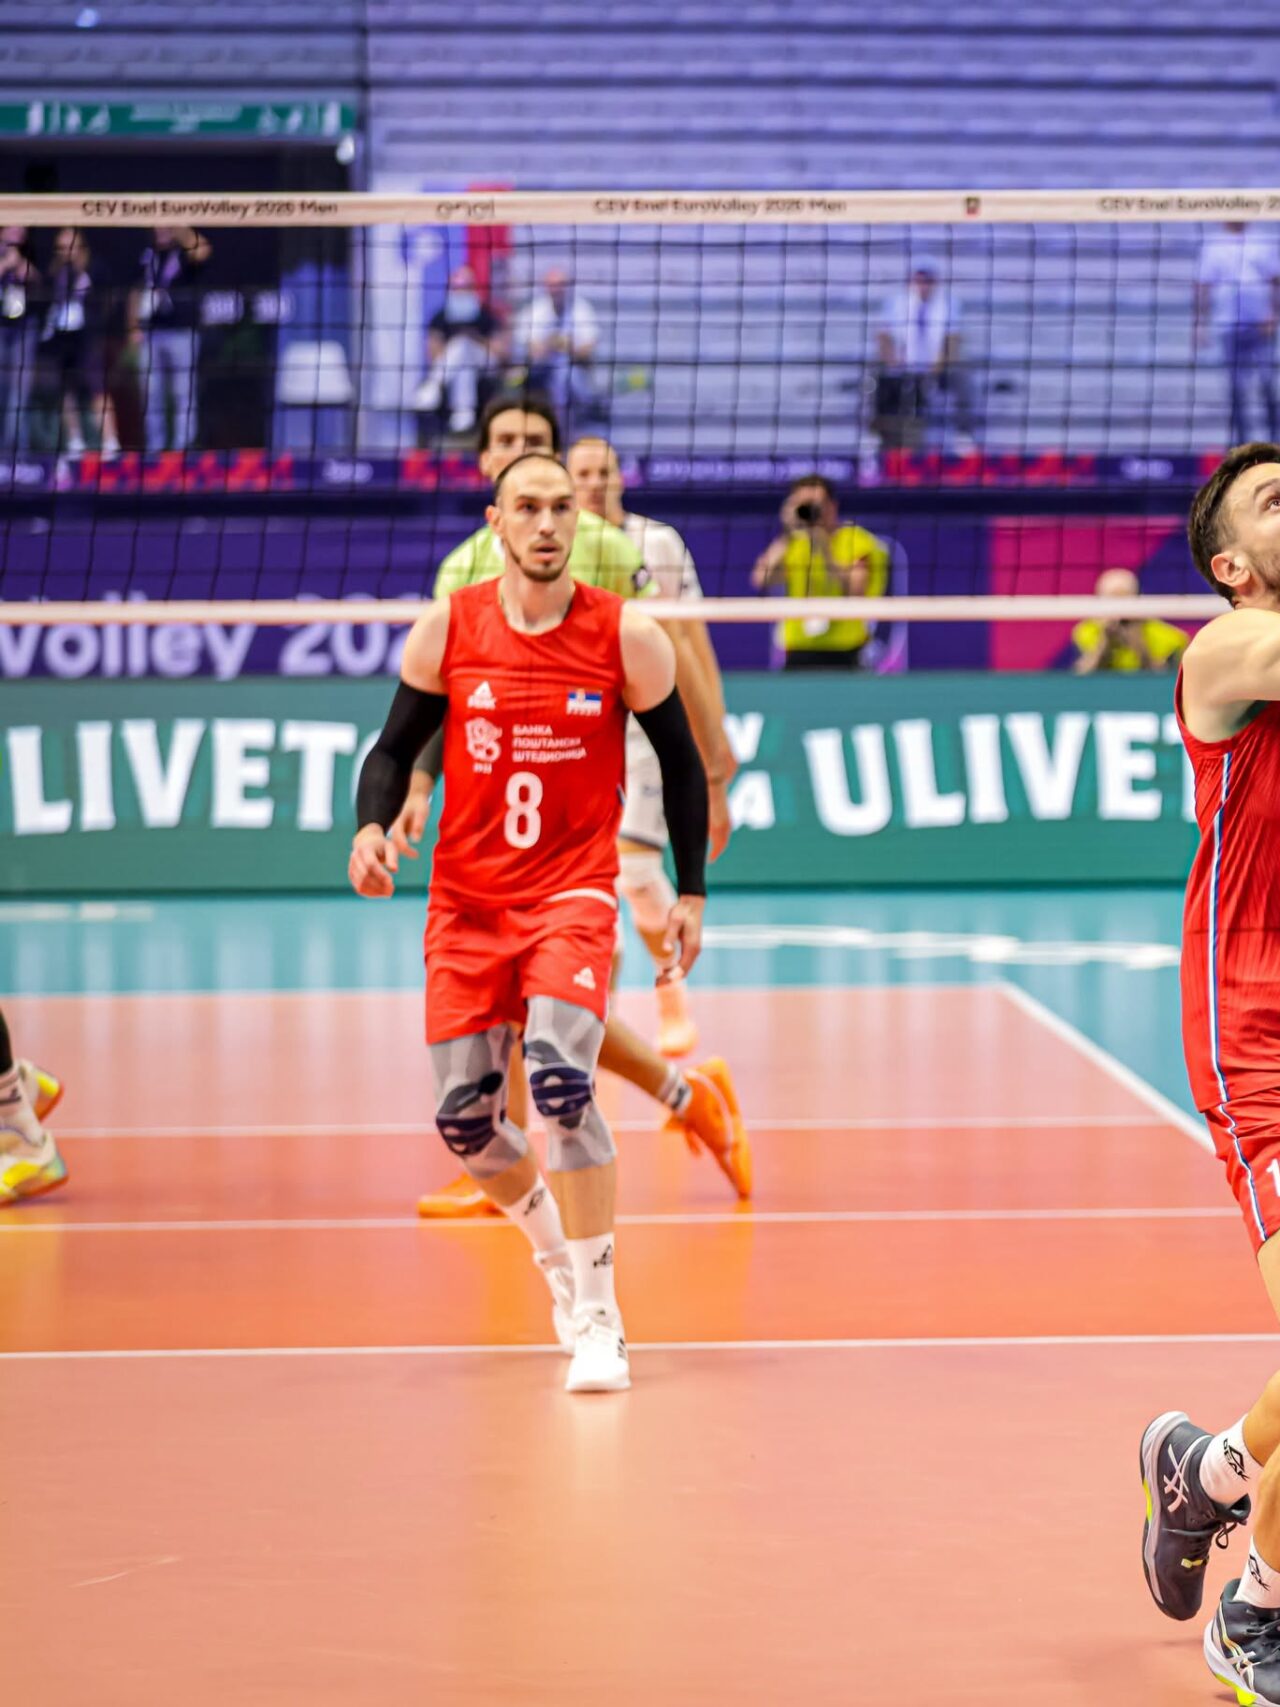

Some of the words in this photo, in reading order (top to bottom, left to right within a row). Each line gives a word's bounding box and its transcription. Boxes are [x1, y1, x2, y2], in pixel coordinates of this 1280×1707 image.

[82, 201, 117, 215] CEV
[122, 200, 156, 215] Enel
[300, 200, 338, 214] Men
[7, 719, 384, 836] LIVET
[504, 771, 543, 849] 8
